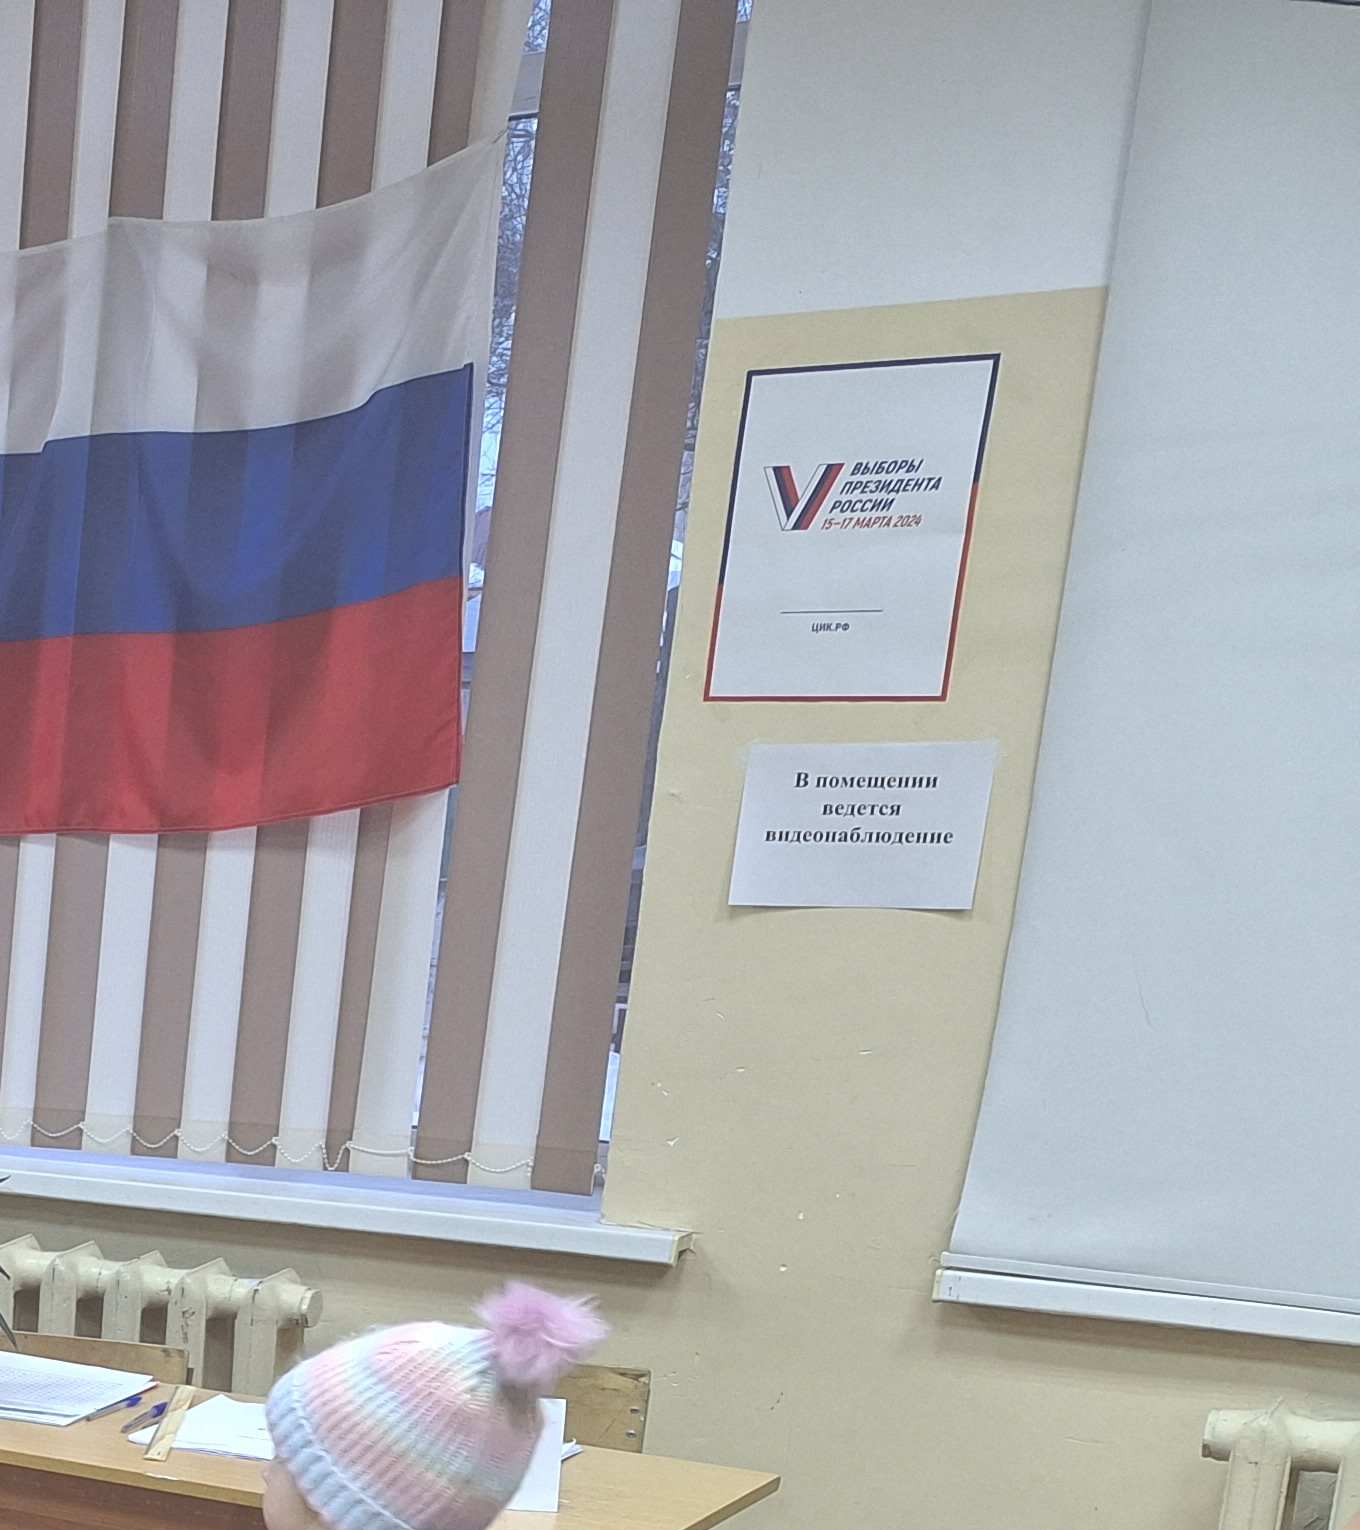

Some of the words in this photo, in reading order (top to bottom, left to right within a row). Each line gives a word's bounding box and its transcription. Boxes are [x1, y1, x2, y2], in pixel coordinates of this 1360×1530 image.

[850, 458, 924, 476] ВЫБОРЫ
[840, 477, 942, 495] ПРЕЗИДЕНТА
[829, 498, 895, 514] РОССИИ
[852, 515, 892, 529] МАРТА
[893, 514, 922, 527] 2024
[811, 622, 850, 633] ЦИК.РФ
[794, 772, 809, 788] В
[816, 775, 939, 790] помещении
[822, 803, 902, 817] ведется
[765, 827, 954, 845] видеонаблюдение
